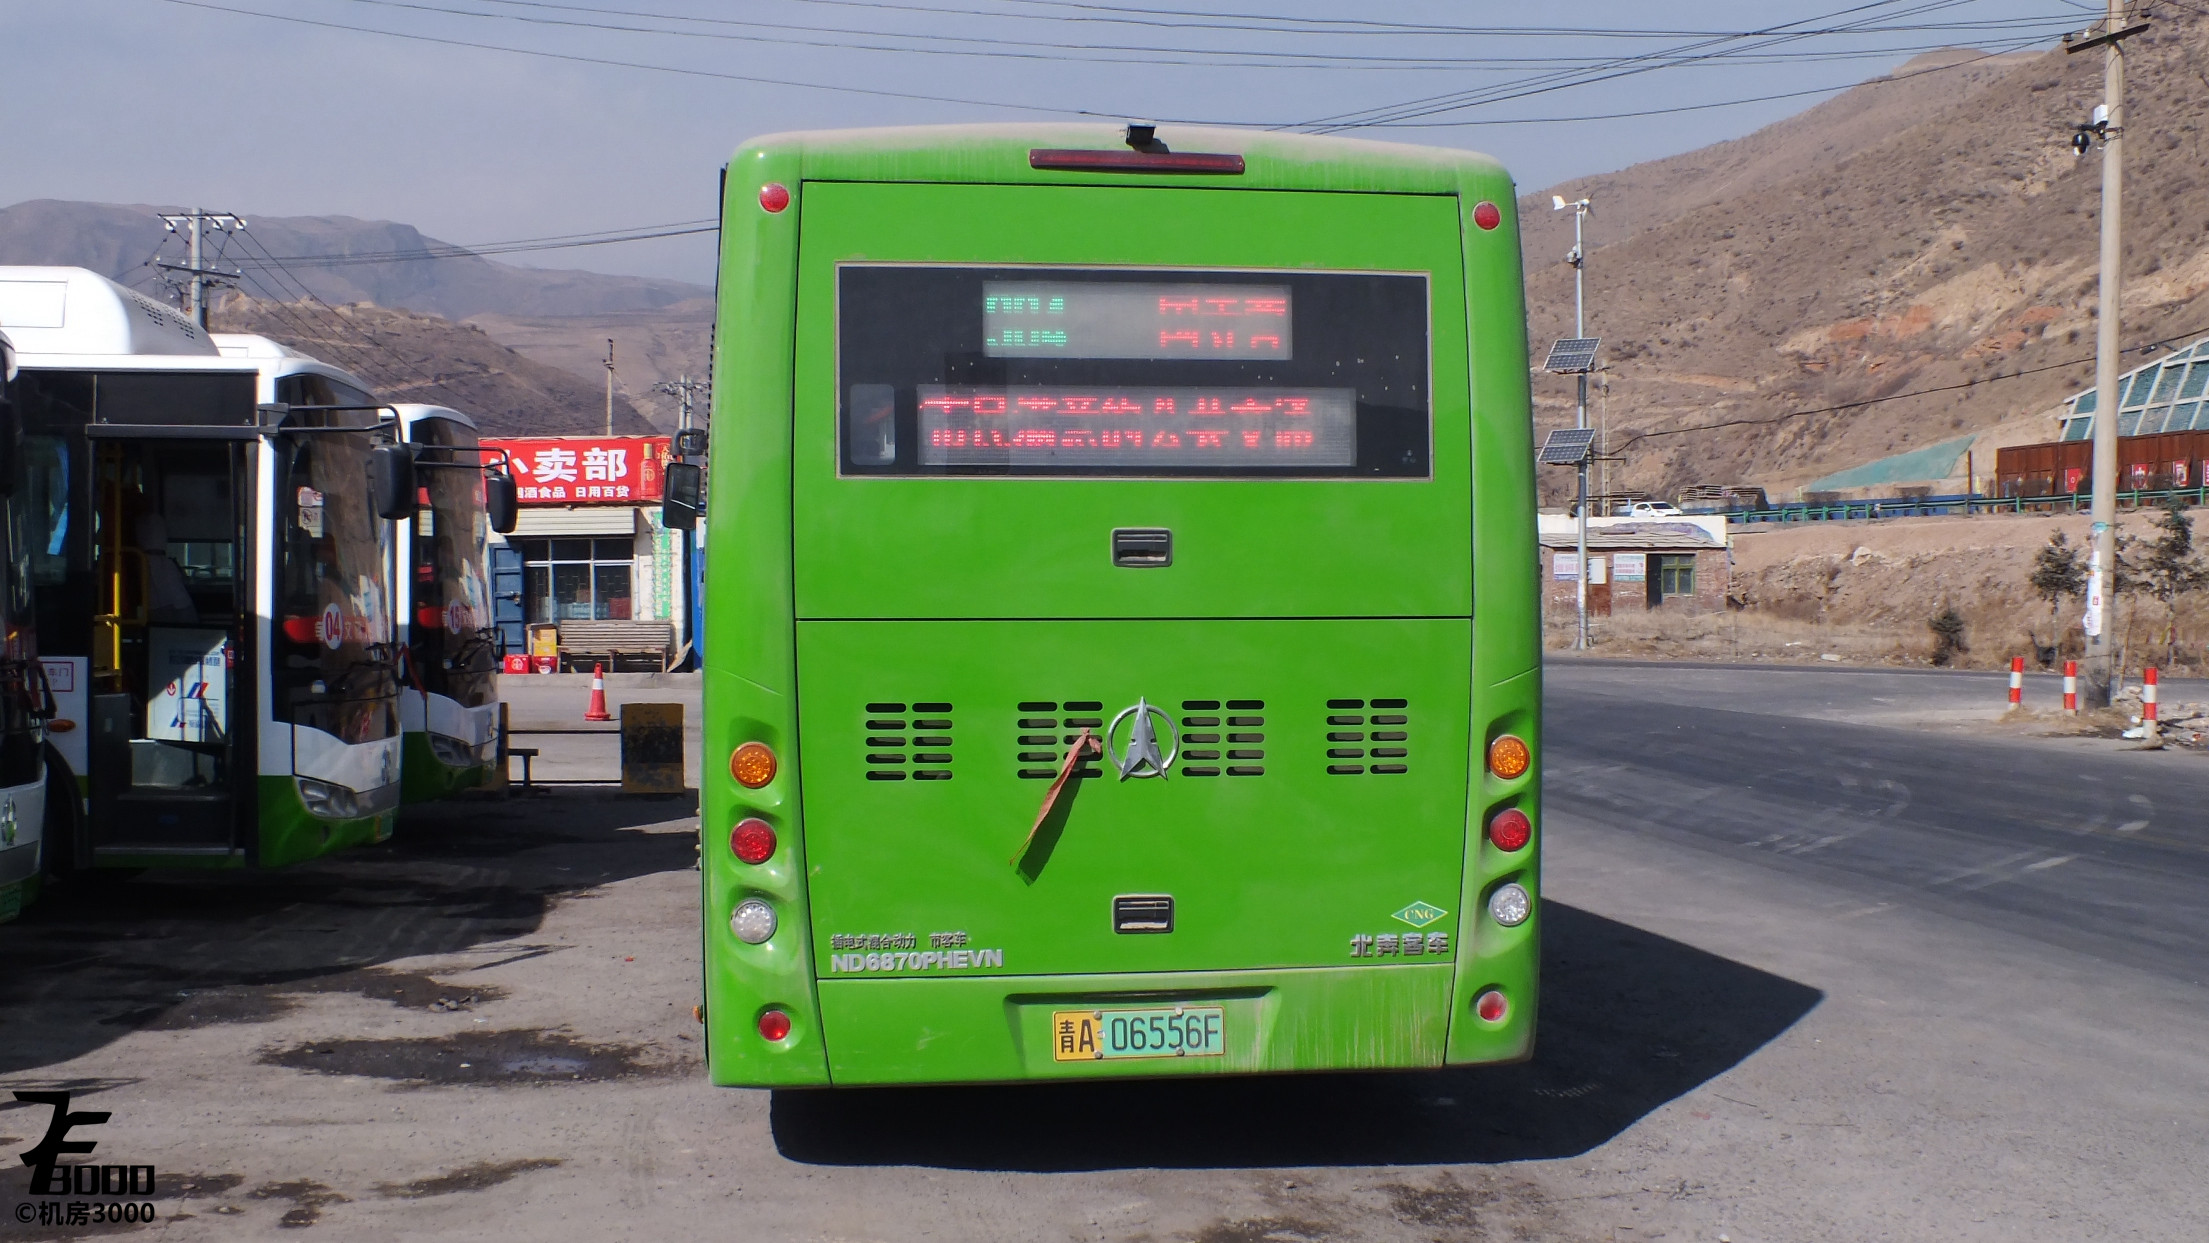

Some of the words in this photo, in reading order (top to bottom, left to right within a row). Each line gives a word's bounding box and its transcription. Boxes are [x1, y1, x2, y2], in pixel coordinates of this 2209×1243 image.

[489, 447, 628, 483] 小卖部
[575, 486, 630, 498] 日用百货
[325, 611, 341, 641] 04
[1404, 909, 1434, 921] CNG
[832, 934, 916, 950] 插电式混合动力
[1350, 931, 1449, 957] 北奔客车
[831, 949, 1003, 973] ND6870PHEVN
[1111, 1014, 1220, 1050] 06556F
